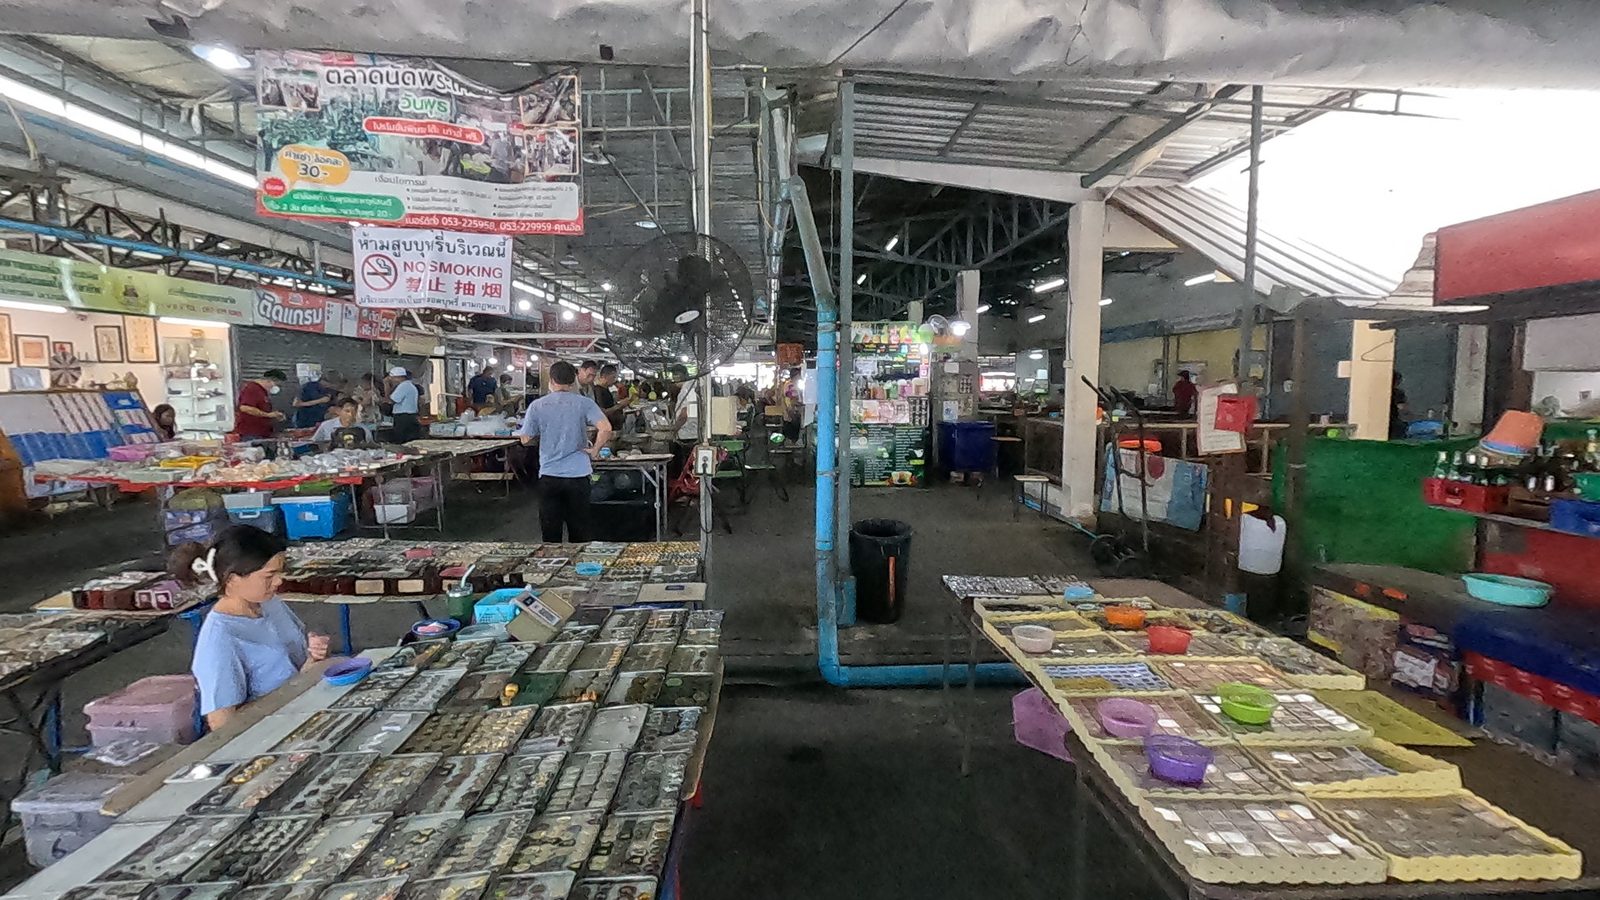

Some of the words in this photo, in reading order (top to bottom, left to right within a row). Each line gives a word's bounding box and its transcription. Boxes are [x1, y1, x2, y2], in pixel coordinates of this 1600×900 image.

[400, 94, 449, 116] วันพุธ
[403, 261, 426, 274] NO
[428, 260, 503, 279] SMOKING
